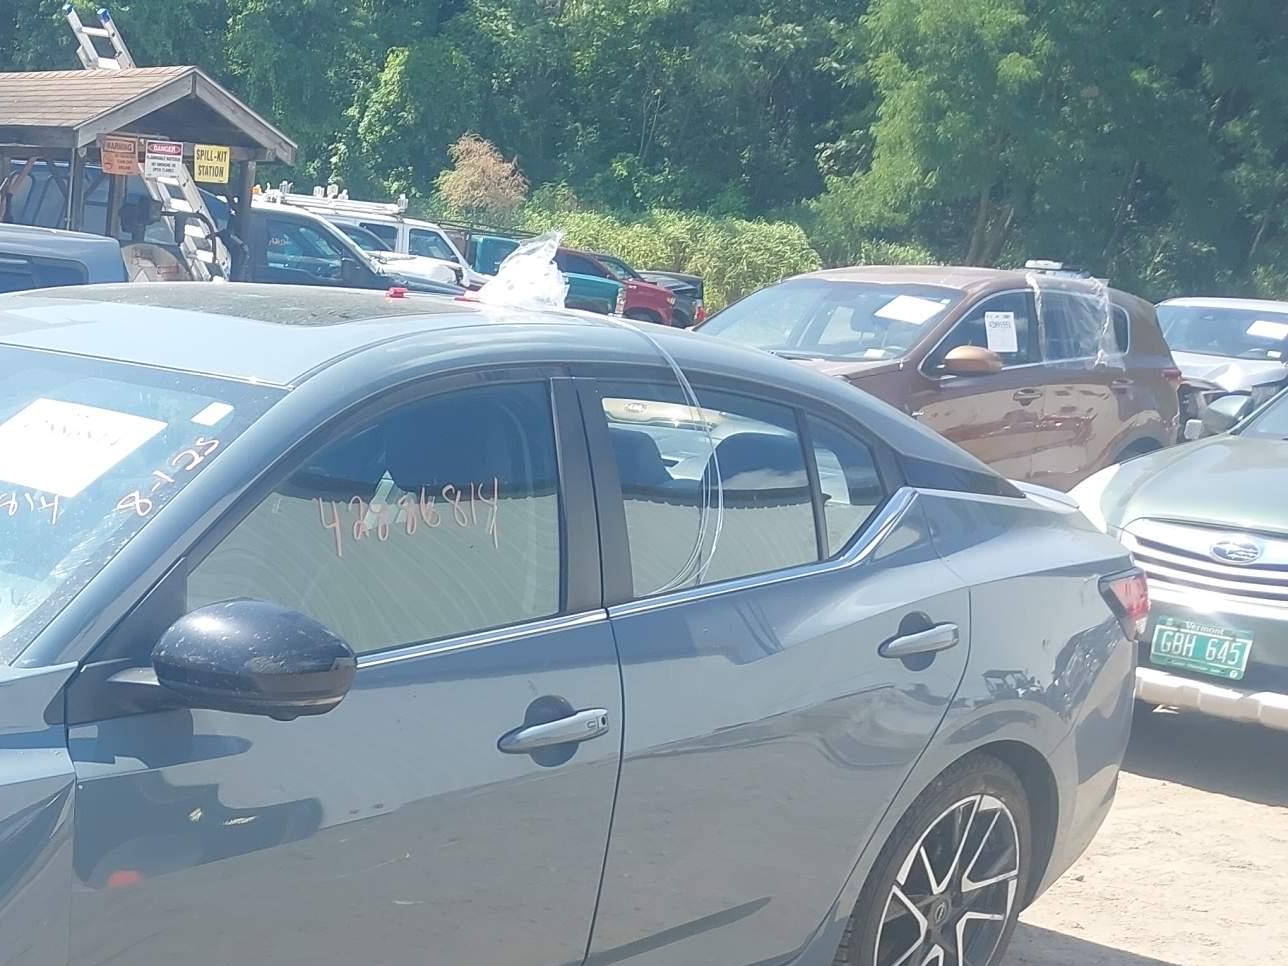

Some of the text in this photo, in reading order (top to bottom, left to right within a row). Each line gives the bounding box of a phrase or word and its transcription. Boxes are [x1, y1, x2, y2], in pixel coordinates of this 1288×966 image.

[153, 144, 176, 153] DANGER
[196, 148, 228, 162] SPILL-KIT
[198, 165, 224, 177] STATION
[1185, 621, 1224, 635] Vermont
[1161, 631, 1242, 665] GBH 645
